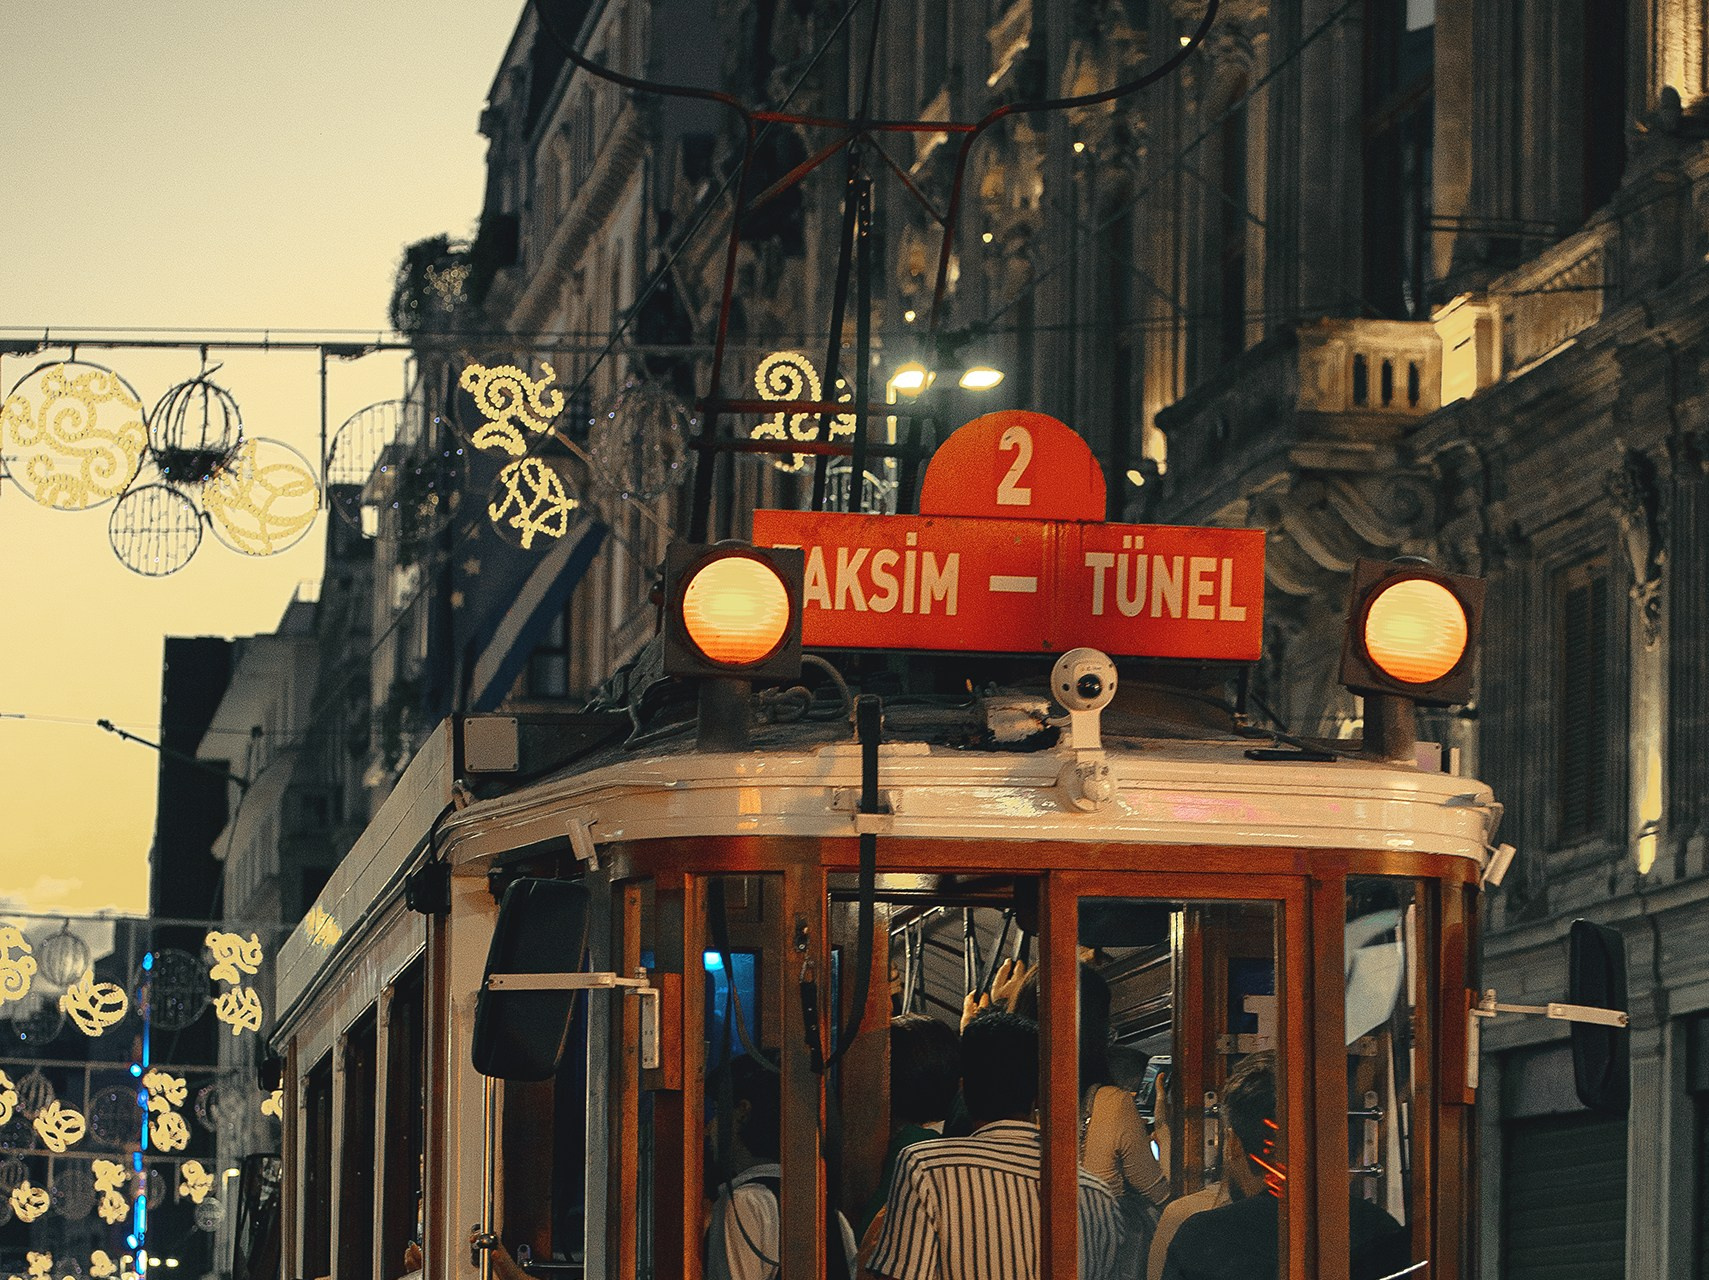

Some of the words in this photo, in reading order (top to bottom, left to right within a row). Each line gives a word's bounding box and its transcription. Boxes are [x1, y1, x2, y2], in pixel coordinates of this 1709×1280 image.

[996, 426, 1034, 506] 2
[772, 531, 960, 616] AKSİM
[1085, 536, 1248, 622] TÜNEL
